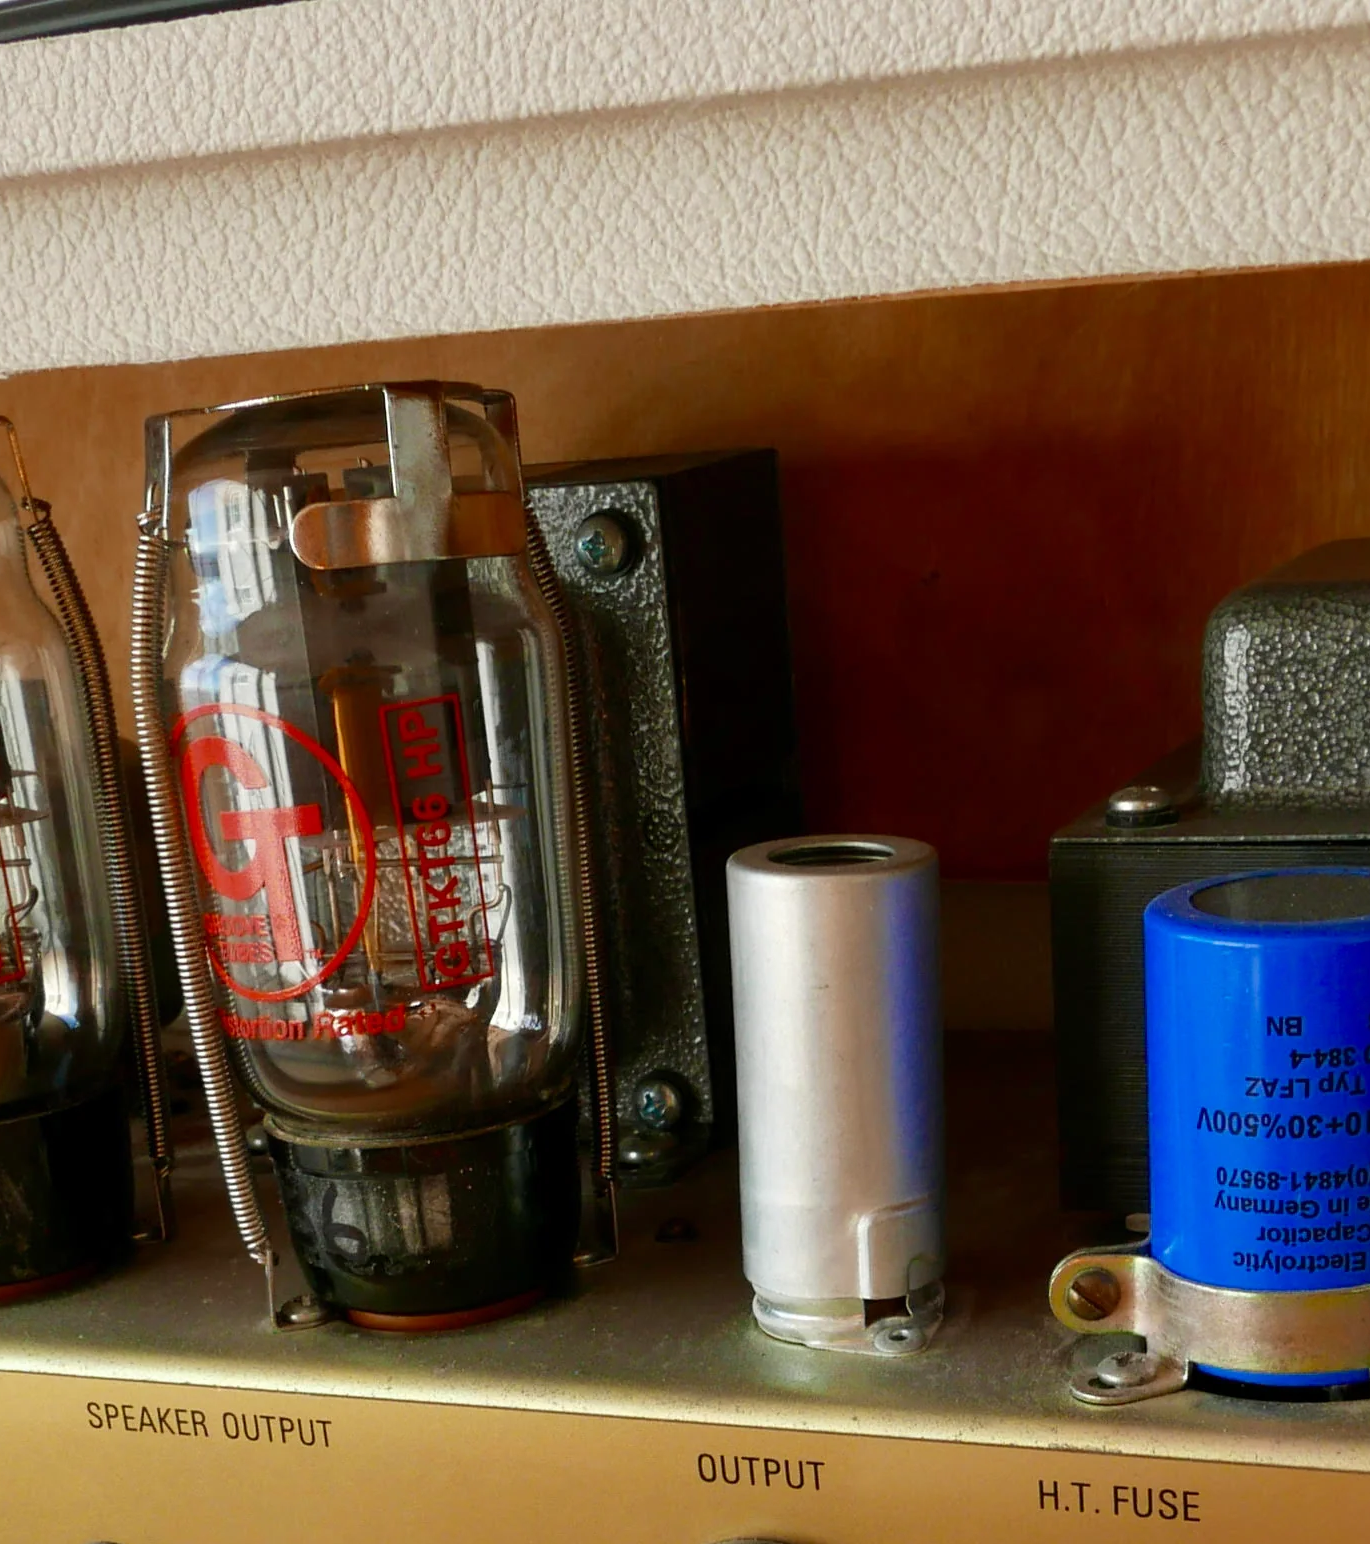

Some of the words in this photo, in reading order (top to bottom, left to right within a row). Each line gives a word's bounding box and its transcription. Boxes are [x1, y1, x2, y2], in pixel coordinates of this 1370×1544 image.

[398, 709, 444, 779] HP
[412, 794, 470, 981] GTKT66
[313, 1003, 405, 1039] Rated
[1266, 1016, 1302, 1036] BN
[1290, 1046, 1355, 1069] 384-4
[1245, 1077, 1309, 1098] LFAZ
[1319, 1072, 1365, 1095] Typ
[1215, 1190, 1320, 1218] Germany
[1328, 1198, 1349, 1217] in
[1232, 1250, 1366, 1273] Electrolytic
[86, 1402, 209, 1439] SPEAKER
[222, 1411, 333, 1448] OUTPUT
[697, 1453, 826, 1491] OUTPUT
[1038, 1479, 1101, 1514] H.T.
[1113, 1485, 1201, 1523] FUSE
